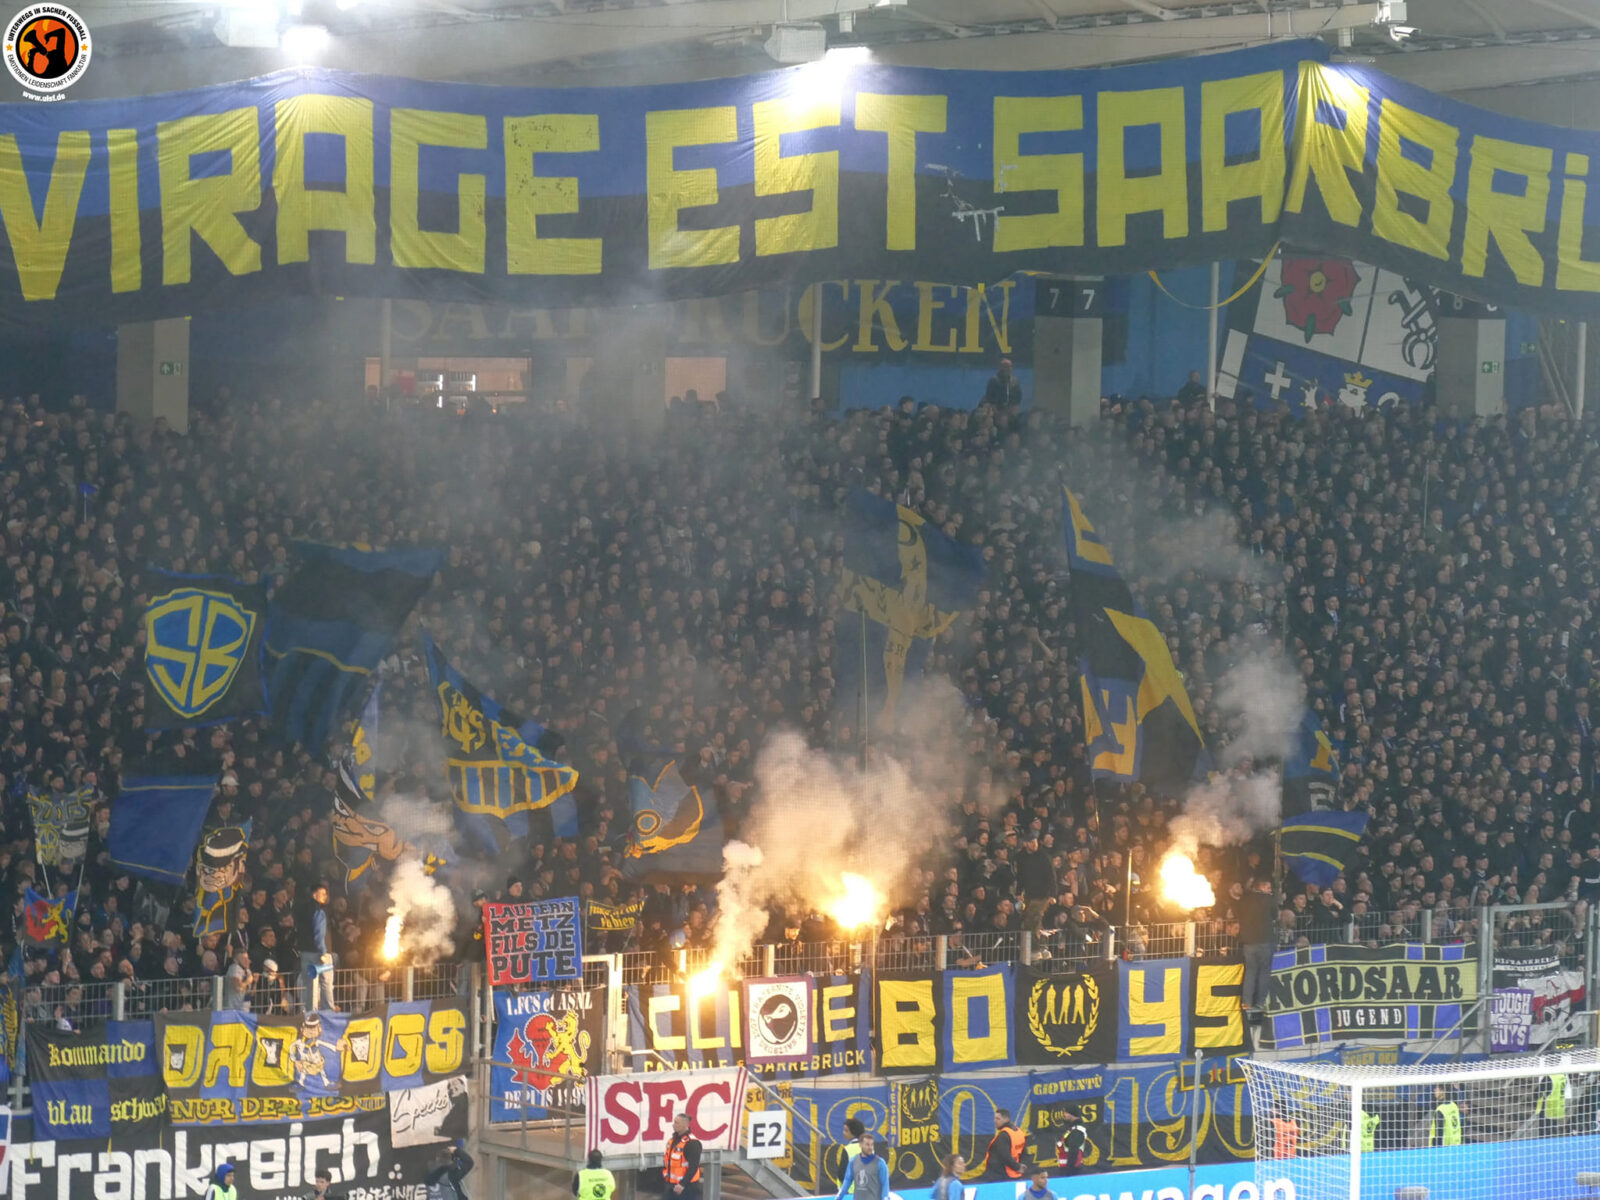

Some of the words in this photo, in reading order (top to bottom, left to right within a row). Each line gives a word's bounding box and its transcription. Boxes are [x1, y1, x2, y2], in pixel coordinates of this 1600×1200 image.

[0, 94, 603, 301] VIRAGE
[646, 92, 948, 270] EST
[1082, 289, 1096, 311] 7
[490, 902, 574, 919] LAUTERN
[491, 914, 575, 935] METZ
[491, 932, 540, 956] FILS
[545, 929, 576, 953] DE
[492, 950, 578, 983] PUTE
[1267, 965, 1463, 1010] NORDSAAR
[1336, 1004, 1403, 1028] JUGEND
[171, 1098, 236, 1124] NUR
[241, 1096, 304, 1121] DER
[600, 1079, 733, 1145] SFC
[752, 1121, 782, 1148] E2
[902, 1124, 940, 1146] BOYS
[8, 1119, 381, 1200] Frankreich
